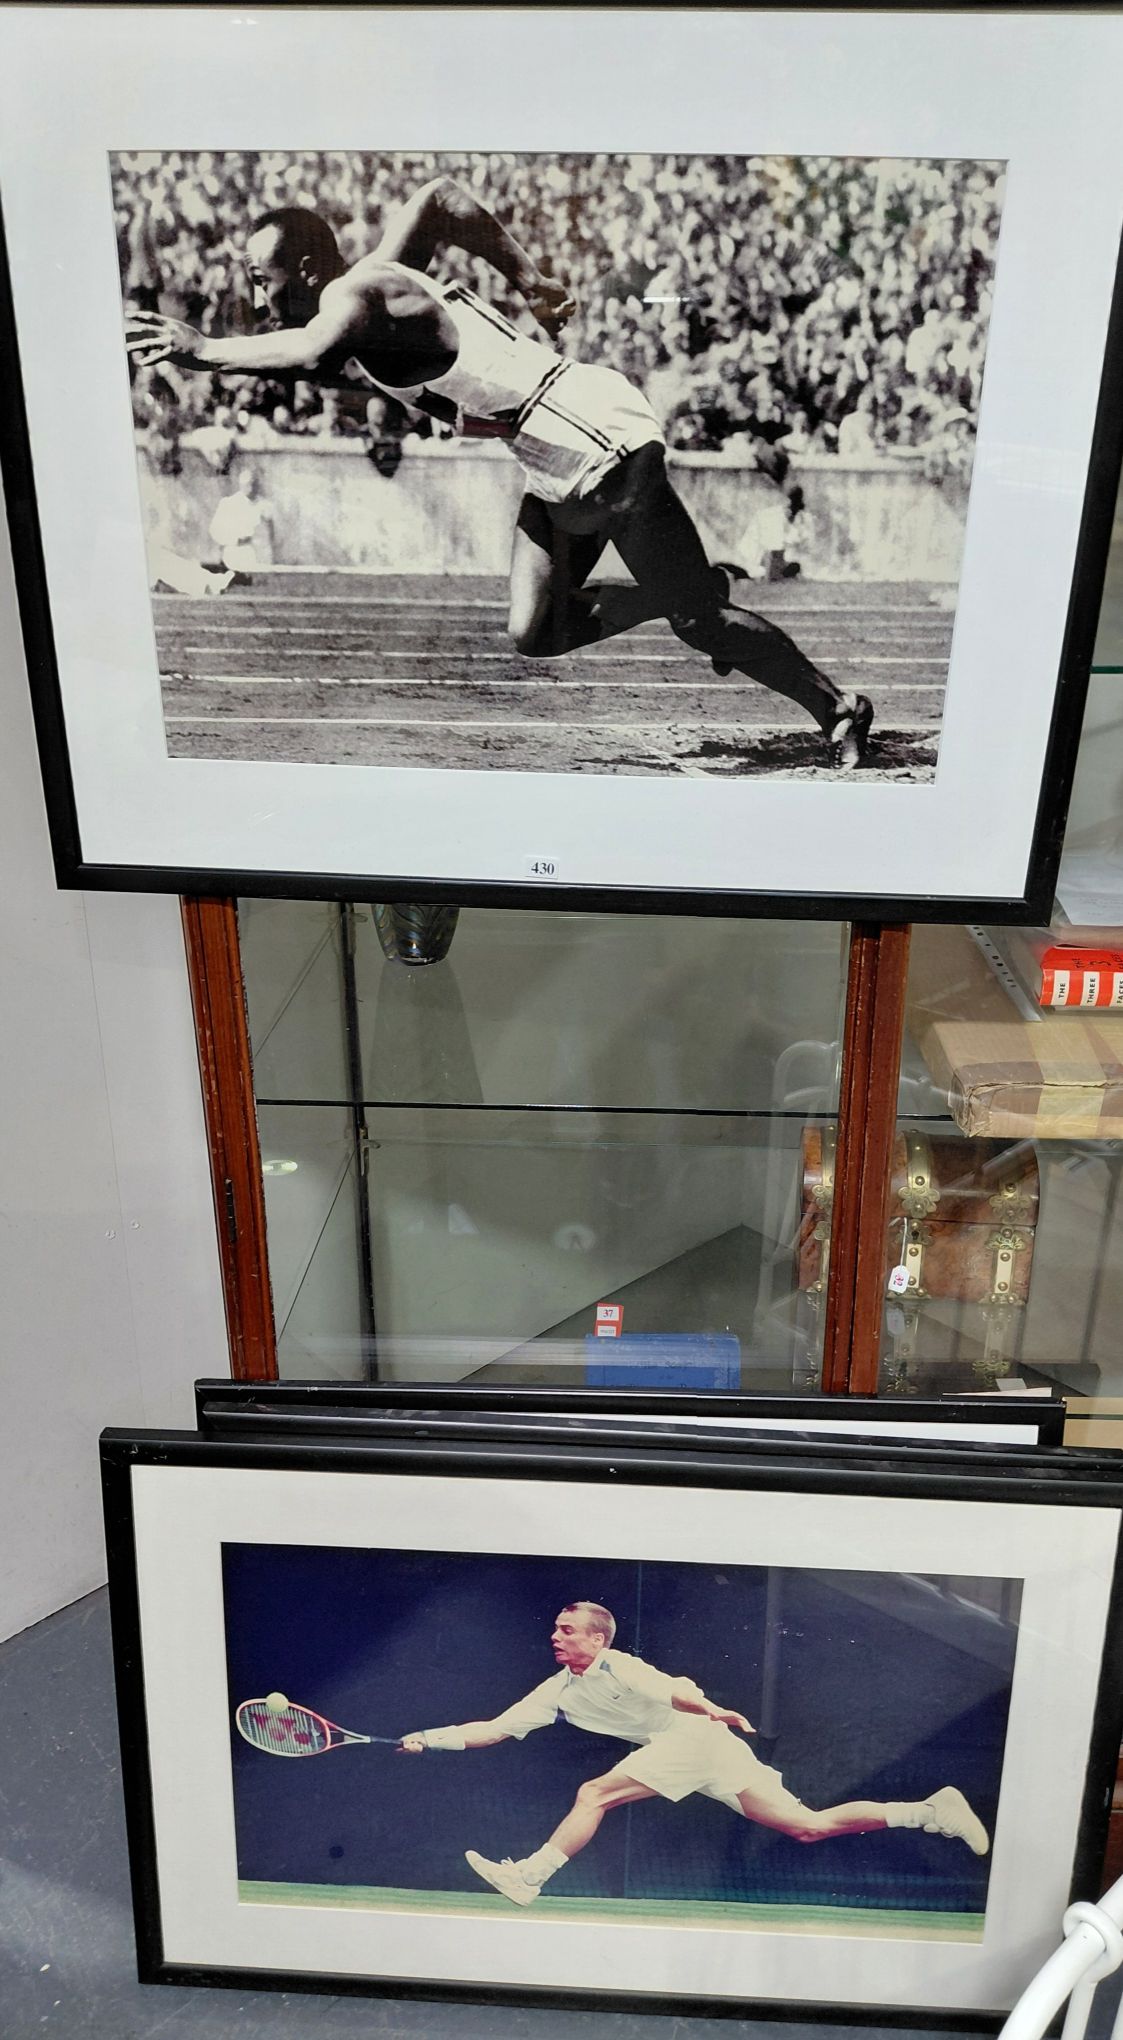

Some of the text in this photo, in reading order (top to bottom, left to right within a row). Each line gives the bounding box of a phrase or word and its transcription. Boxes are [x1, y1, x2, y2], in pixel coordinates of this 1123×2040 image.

[531, 862, 555, 875] 430
[1058, 983, 1066, 999] THE
[1087, 978, 1096, 1004] THREE
[893, 1274, 904, 1287] 32
[603, 1309, 614, 1319] 37
